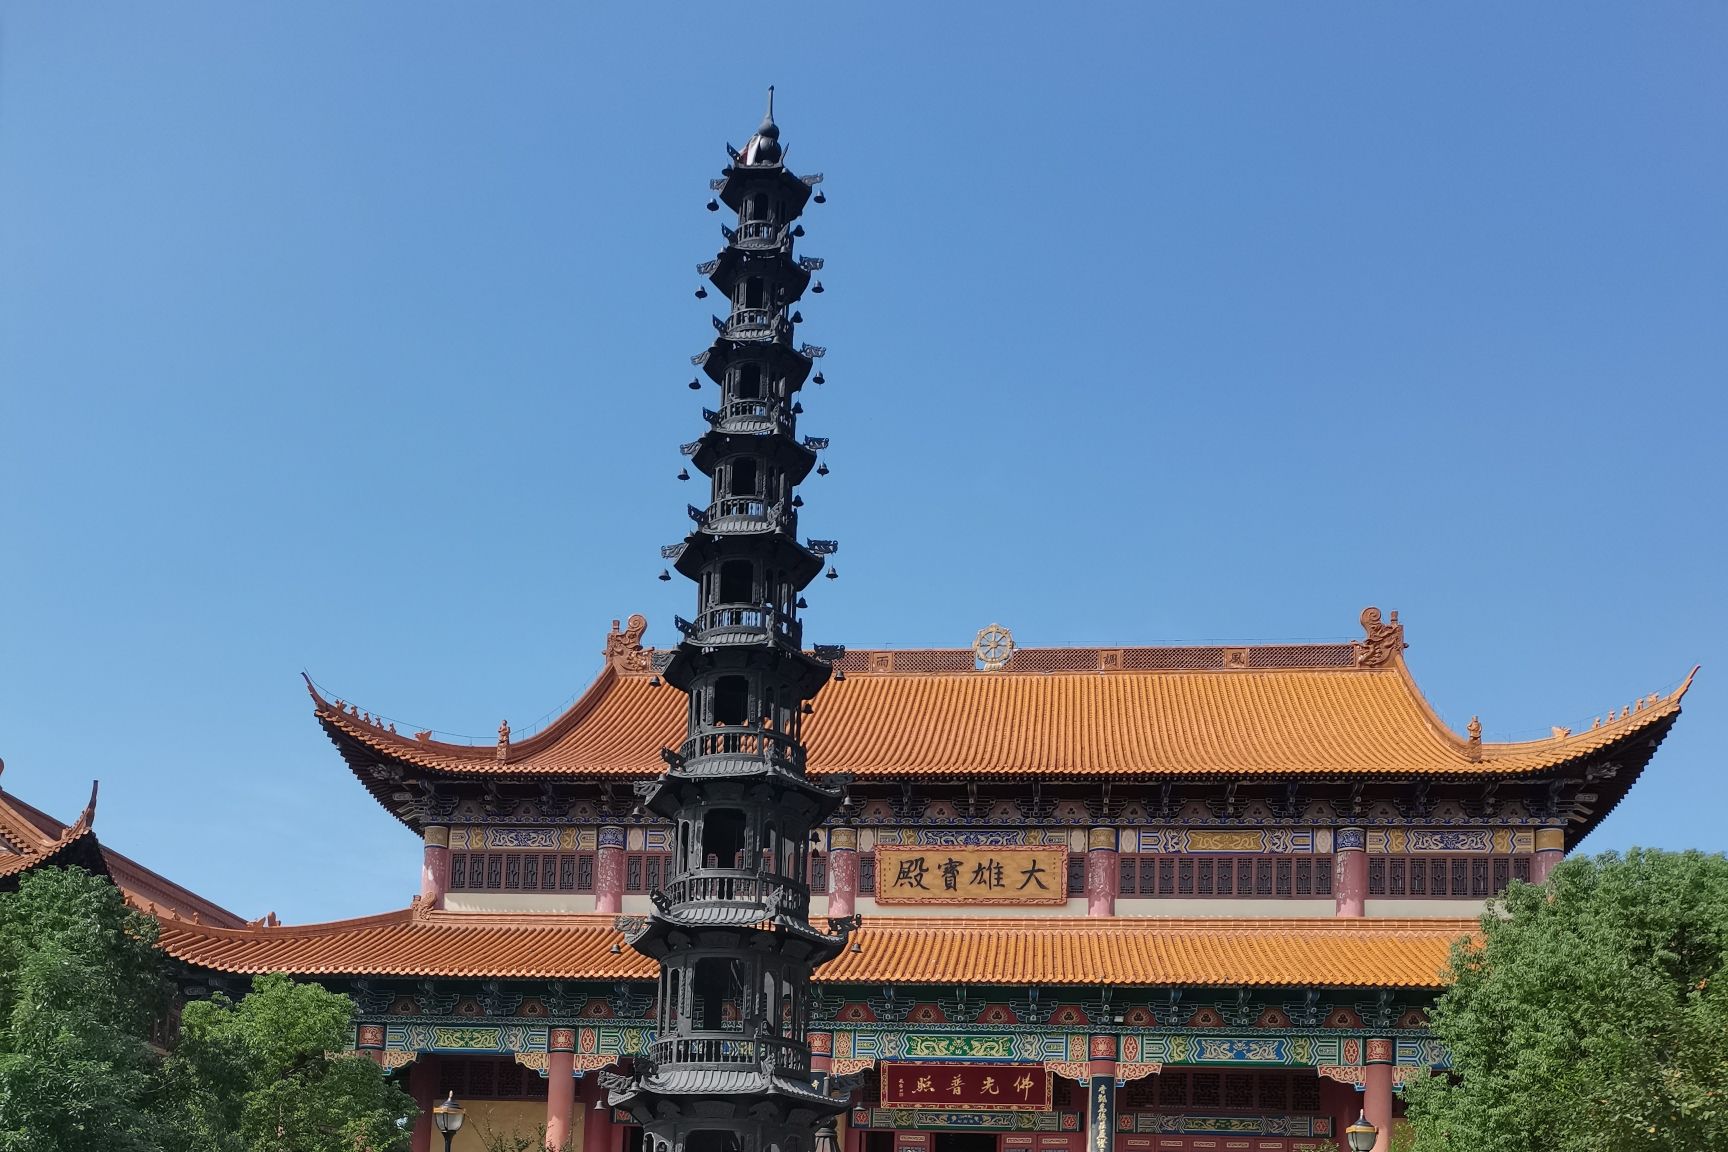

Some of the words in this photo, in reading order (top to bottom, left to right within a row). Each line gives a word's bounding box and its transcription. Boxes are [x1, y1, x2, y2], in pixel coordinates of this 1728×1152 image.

[891, 856, 1050, 893] 大雄寶殿
[911, 1072, 1035, 1102] 佛光普照
